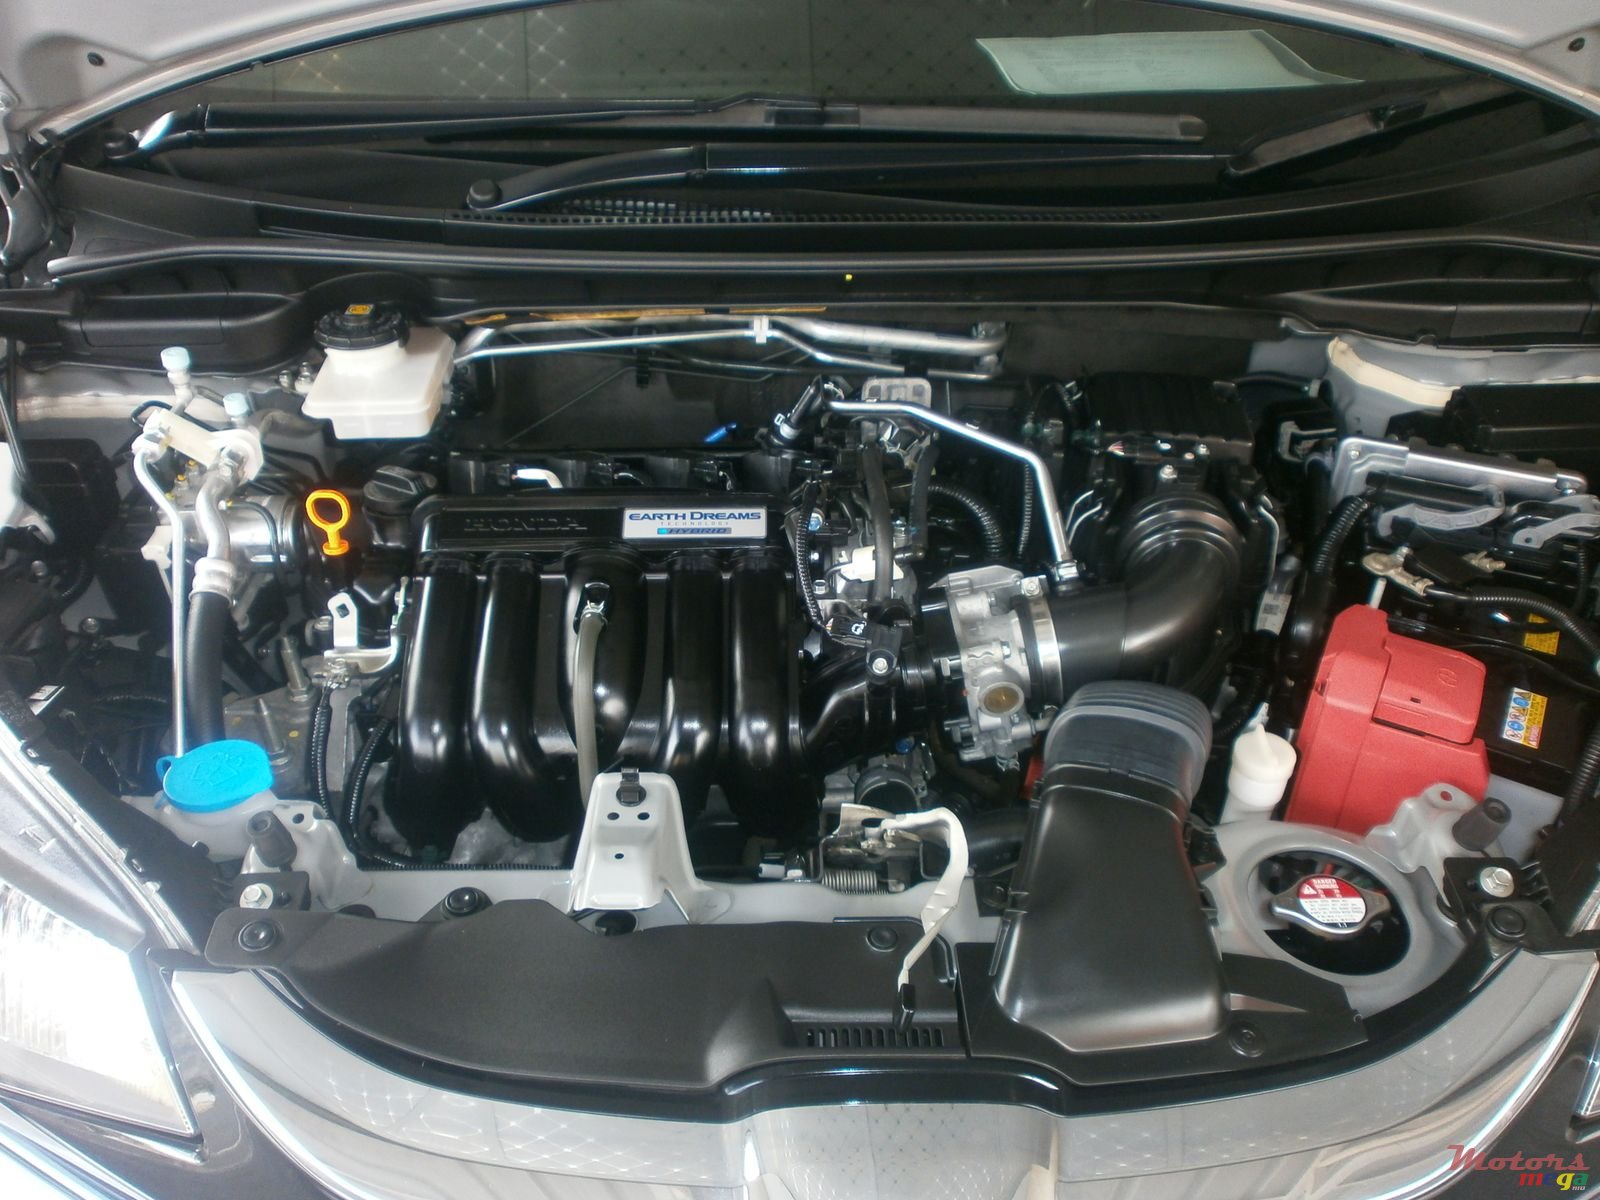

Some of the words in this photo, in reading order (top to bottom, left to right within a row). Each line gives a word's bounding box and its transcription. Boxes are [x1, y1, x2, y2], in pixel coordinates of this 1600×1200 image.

[628, 512, 687, 521] EARTH
[690, 511, 761, 520] DREAMS
[464, 518, 588, 531] HONDA
[668, 527, 728, 535] HYBRID
